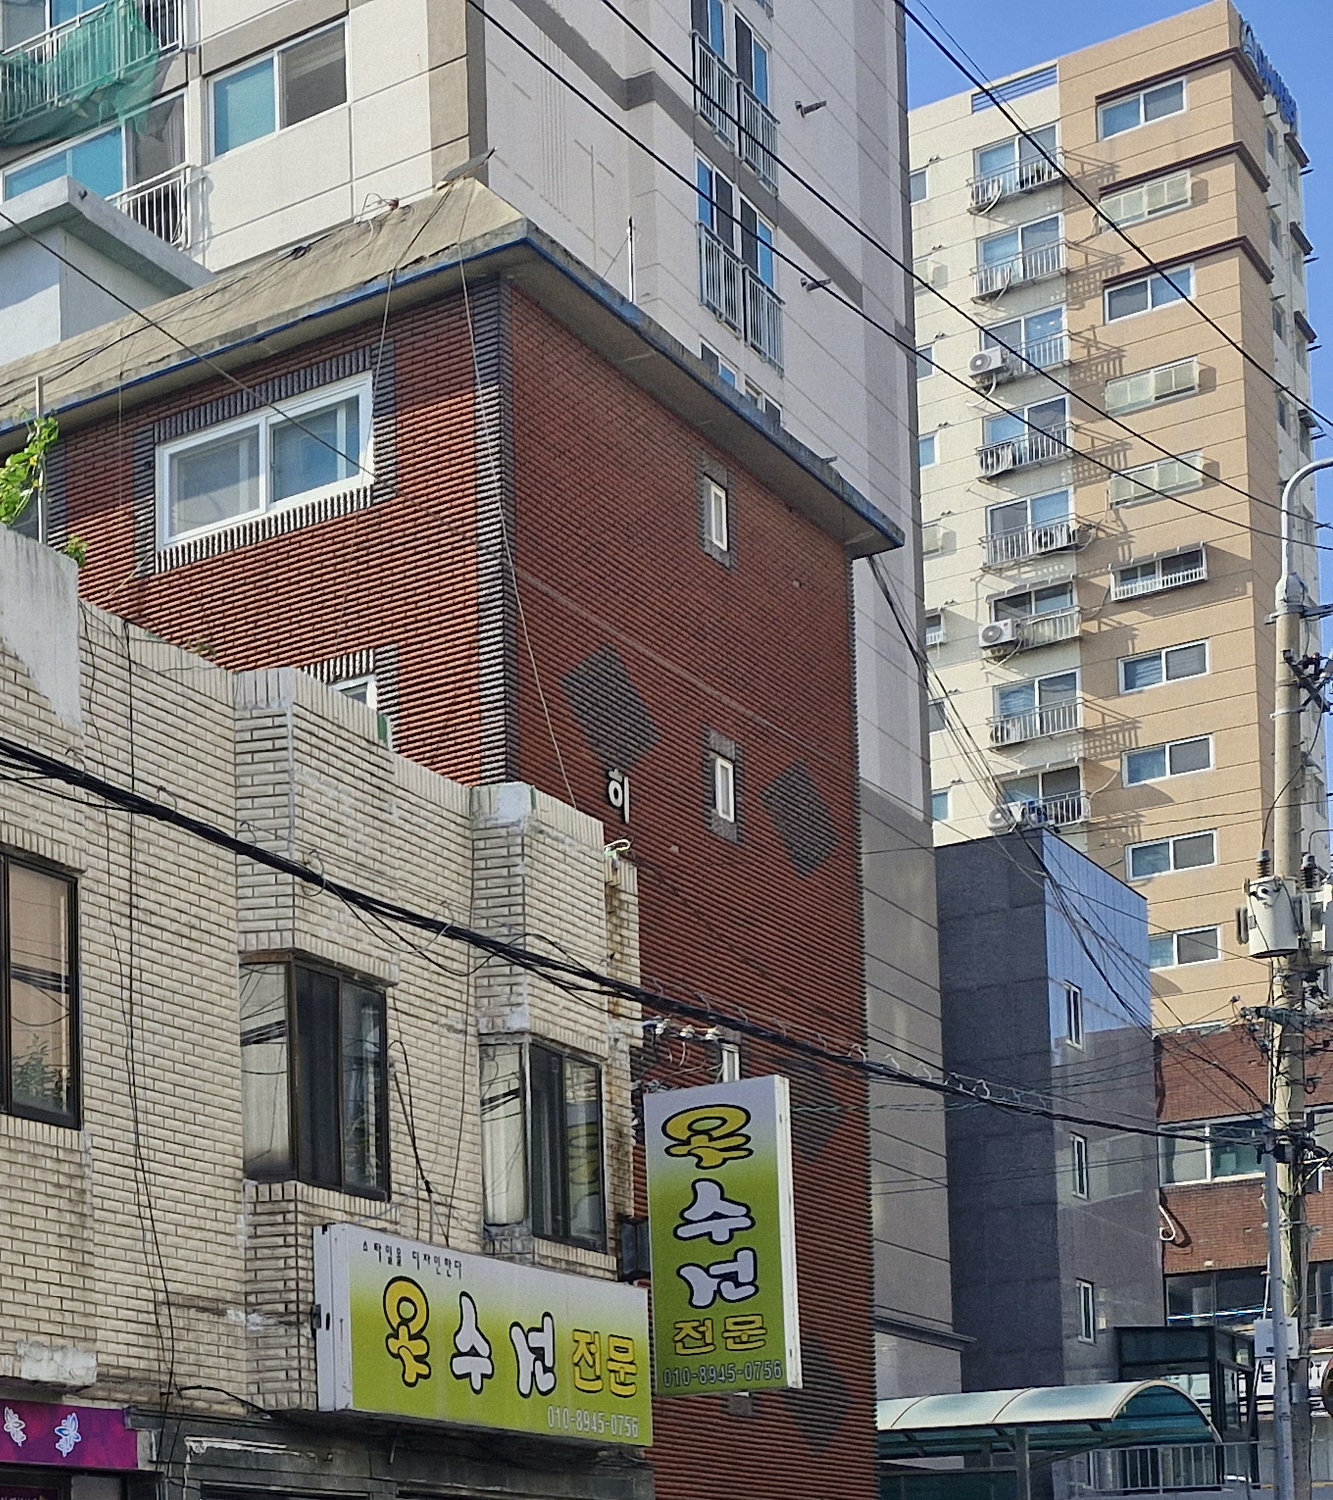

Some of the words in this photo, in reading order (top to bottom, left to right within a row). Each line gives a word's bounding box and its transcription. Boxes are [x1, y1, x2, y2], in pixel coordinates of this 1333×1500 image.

[661, 1103, 759, 1309] 옷수선
[363, 1240, 401, 1267] 스타일을
[383, 1275, 557, 1398] 옷수선
[572, 1329, 637, 1398] 전문
[673, 1314, 767, 1356] 전문
[663, 1359, 782, 1387] 010-8945-0756
[547, 1405, 639, 1438] 010-8945-0756
